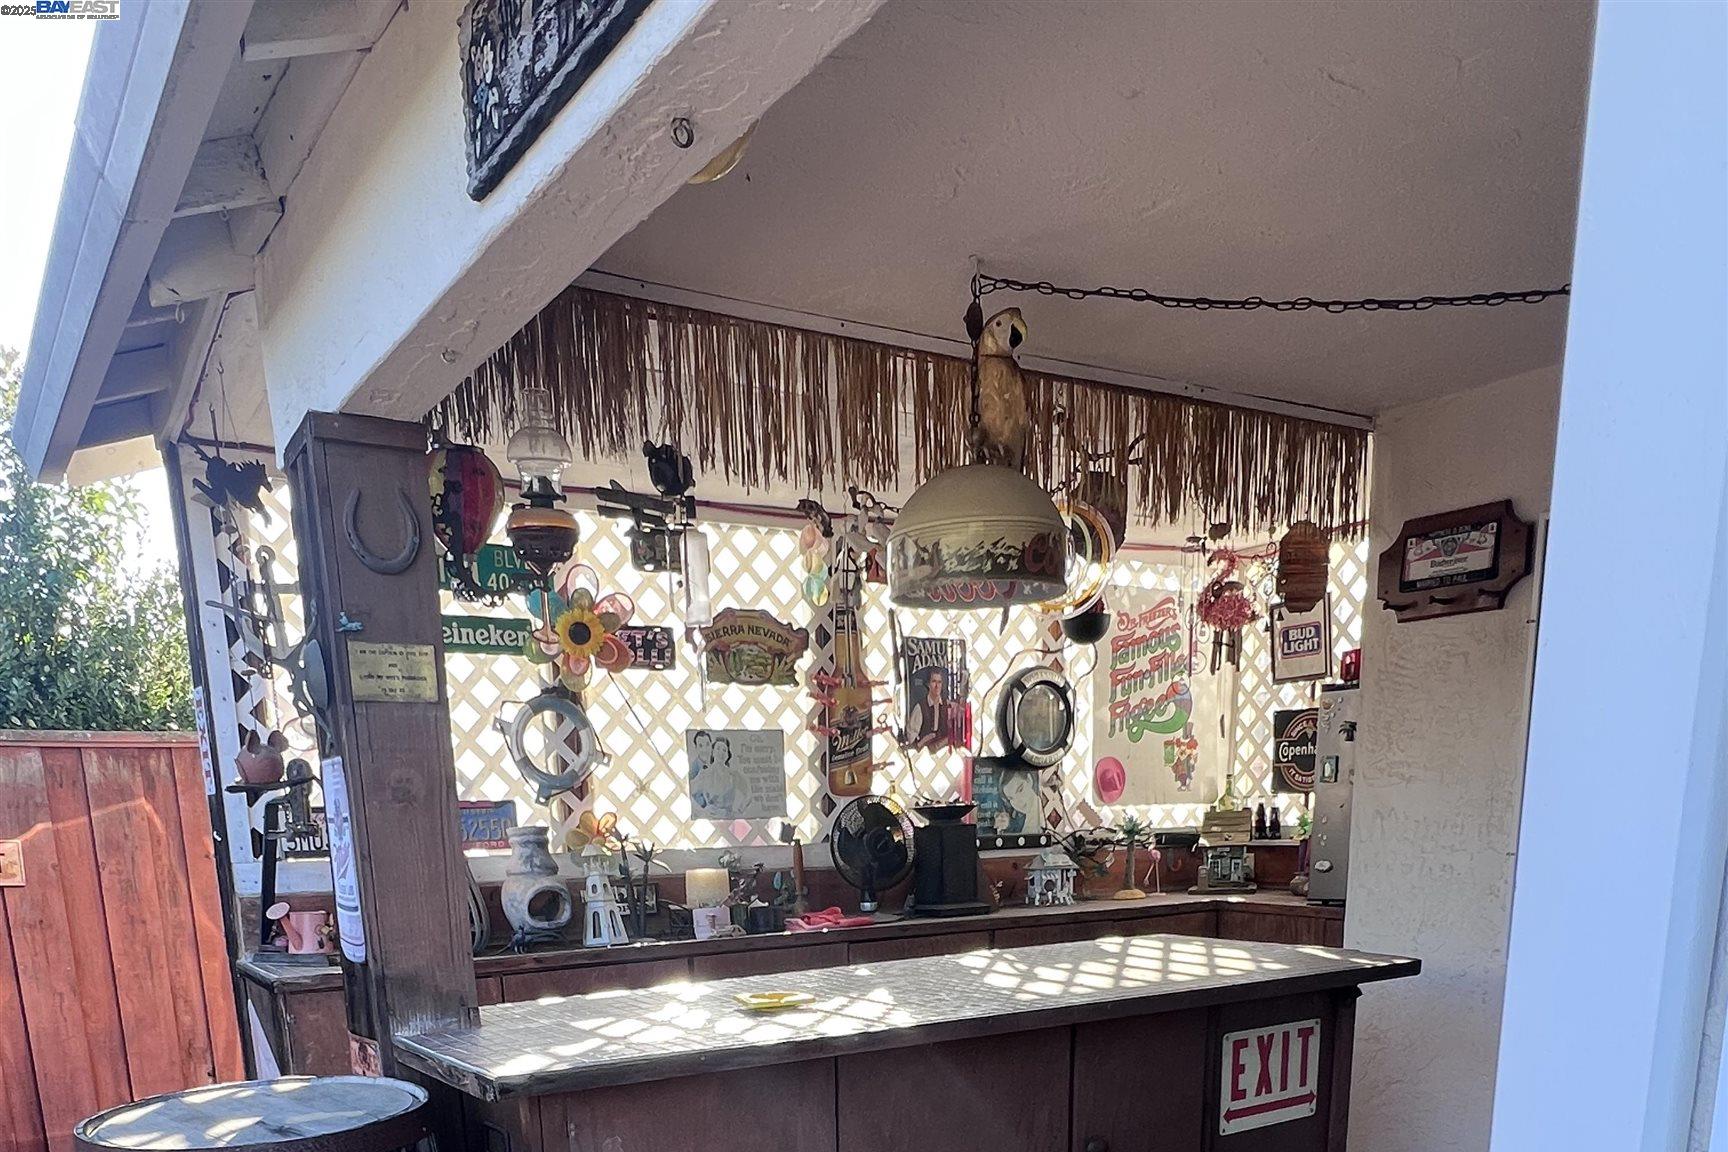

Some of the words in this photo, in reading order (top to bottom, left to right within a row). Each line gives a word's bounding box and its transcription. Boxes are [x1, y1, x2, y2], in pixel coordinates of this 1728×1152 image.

[494, 550, 530, 569] BLV
[704, 625, 745, 644] SIERRA
[749, 625, 791, 646] NEVADA
[1288, 626, 1316, 641] BUD
[908, 638, 946, 656] SAMU
[1283, 638, 1319, 654] LIGHT
[912, 655, 948, 674] ADAM
[1230, 1027, 1314, 1102] EXIT
